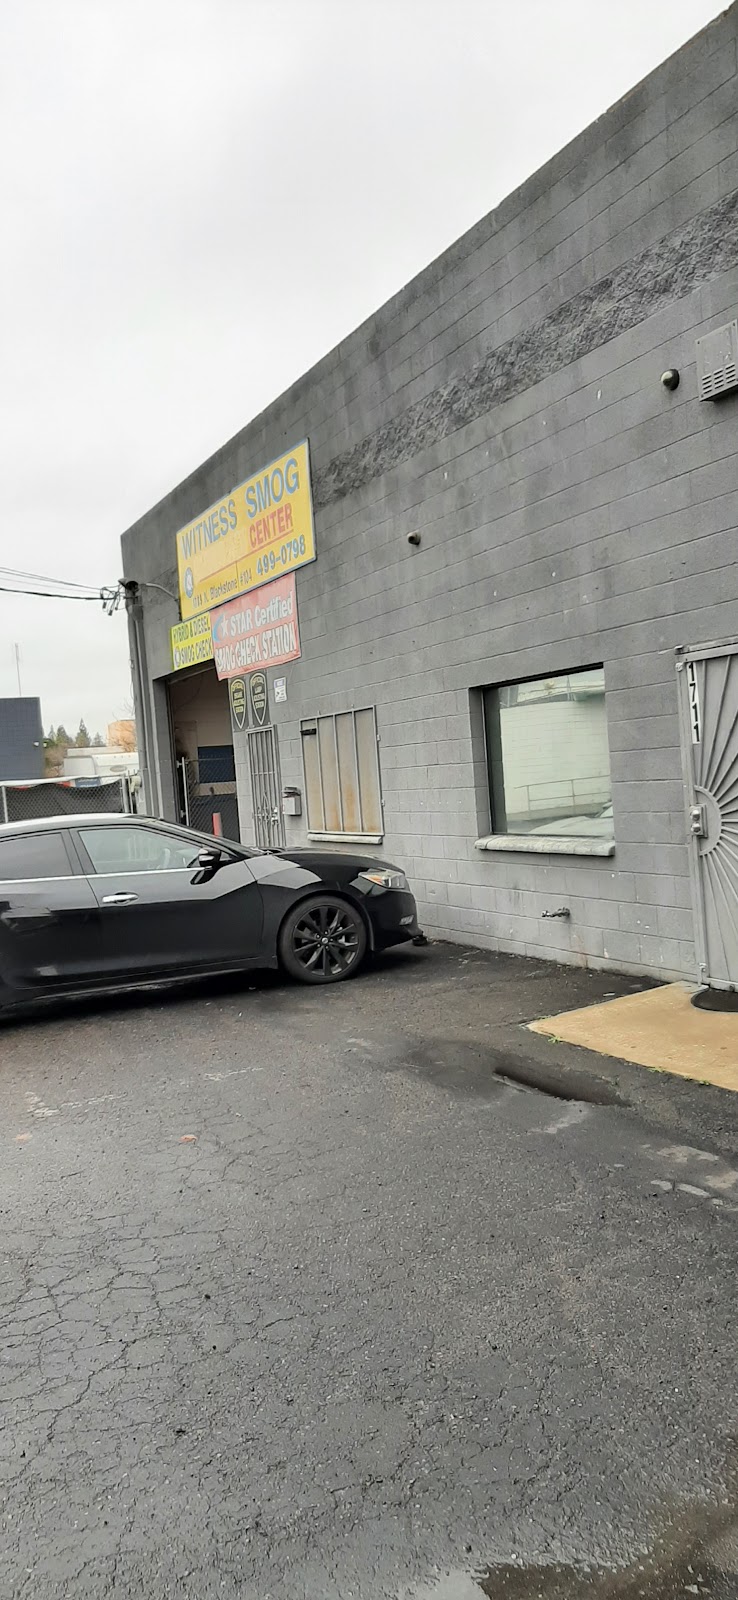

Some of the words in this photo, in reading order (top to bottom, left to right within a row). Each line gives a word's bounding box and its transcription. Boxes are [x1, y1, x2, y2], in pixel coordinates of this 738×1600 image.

[181, 499, 238, 560] WITNESS
[245, 457, 301, 519] SMOG
[249, 502, 294, 548] CENTER
[256, 534, 306, 575] 499-0798
[210, 578, 238, 600] Blackstone
[173, 624, 189, 644] HYBRID
[193, 616, 210, 636] DIESEL
[230, 608, 254, 637] STAR
[254, 590, 294, 627] Certified
[181, 644, 195, 664] SMOG
[195, 637, 212, 661] CHECK
[235, 633, 261, 668] CHECK
[262, 621, 297, 660] STATION
[688, 661, 700, 742] 1711
